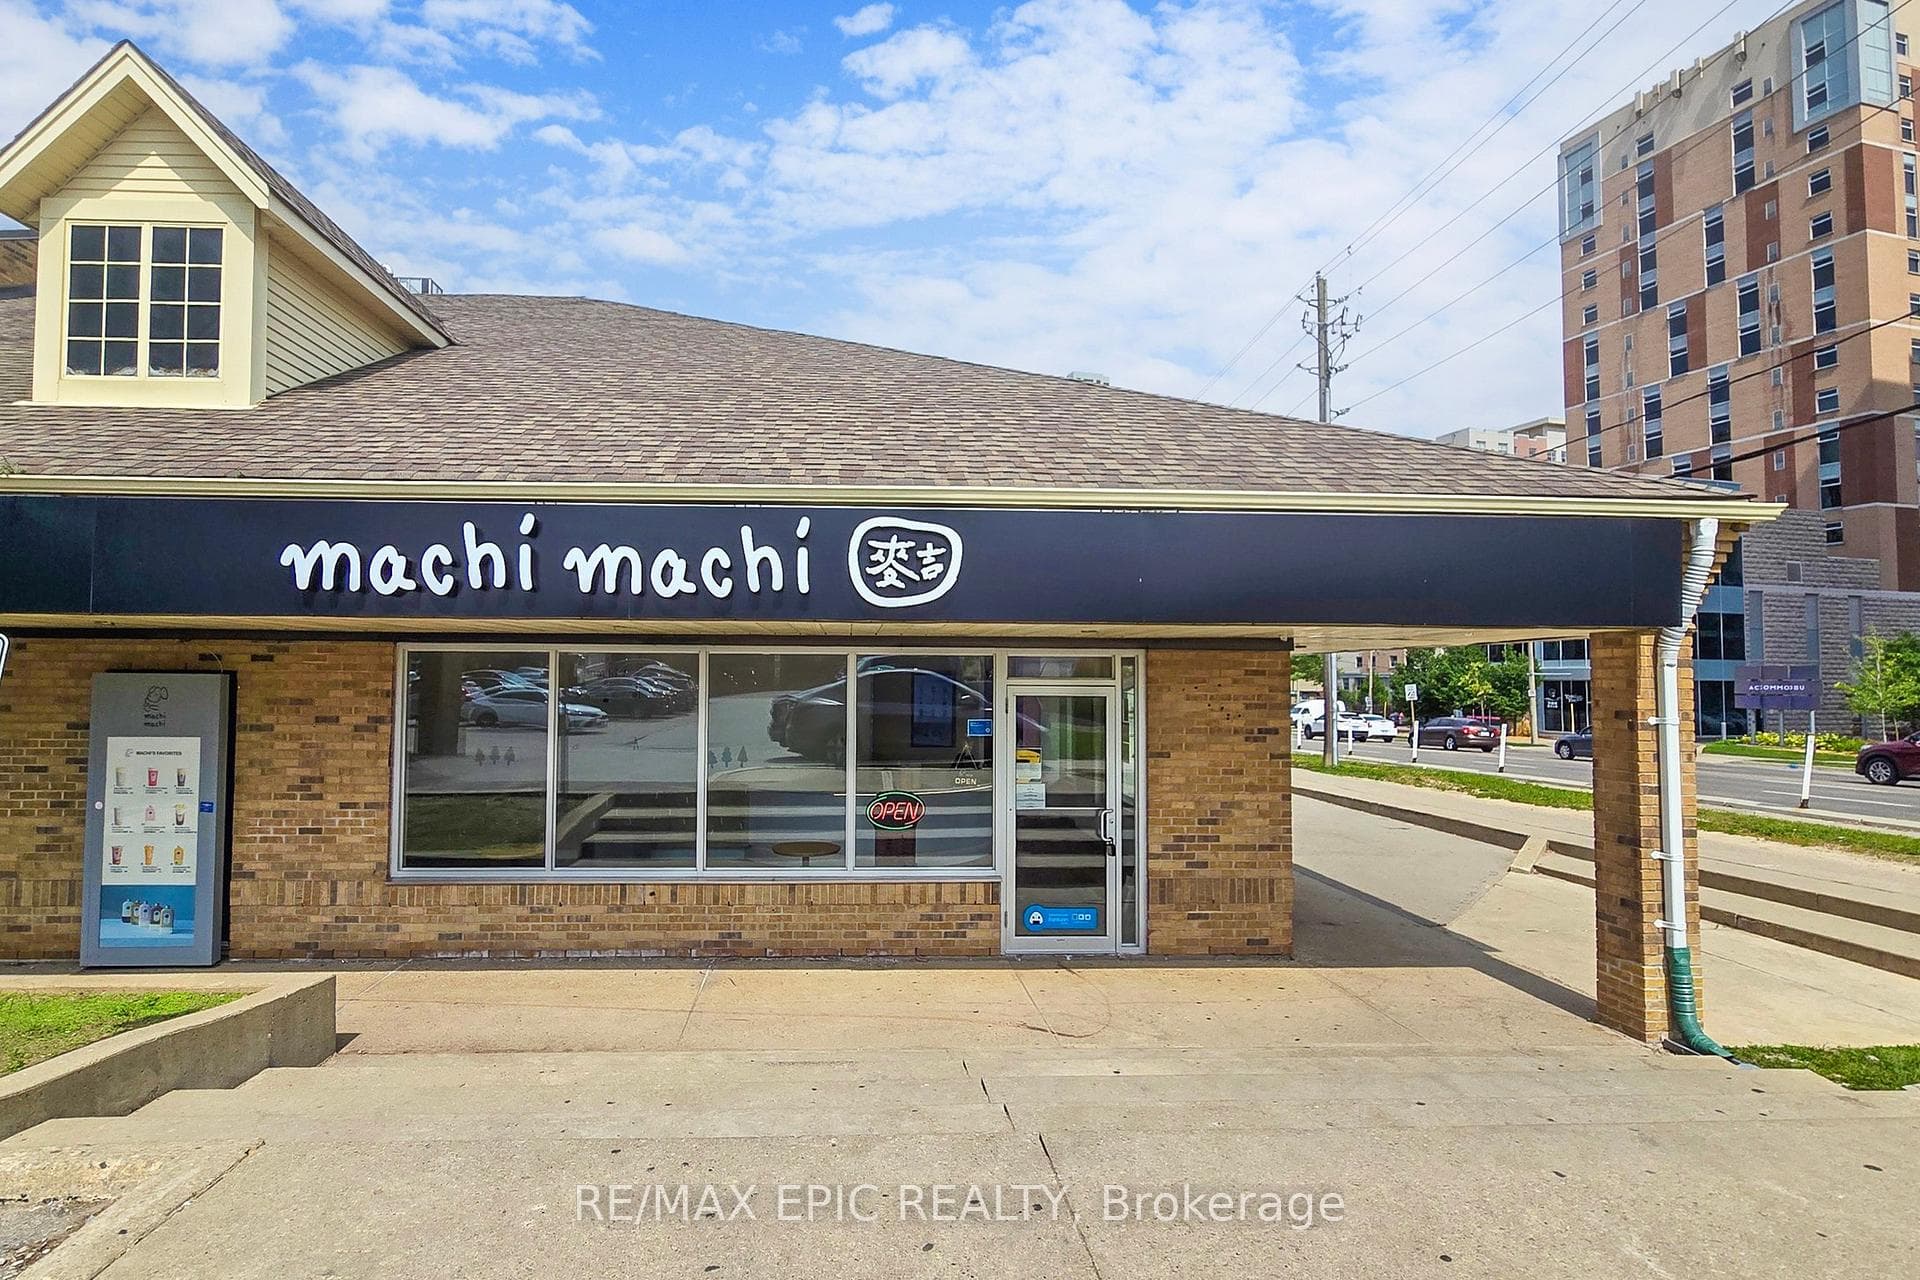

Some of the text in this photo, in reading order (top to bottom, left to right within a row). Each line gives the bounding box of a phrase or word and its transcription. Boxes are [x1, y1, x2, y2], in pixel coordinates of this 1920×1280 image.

[280, 512, 812, 598] machi machi
[955, 777, 977, 785] OPEN
[869, 801, 920, 821] OPEN
